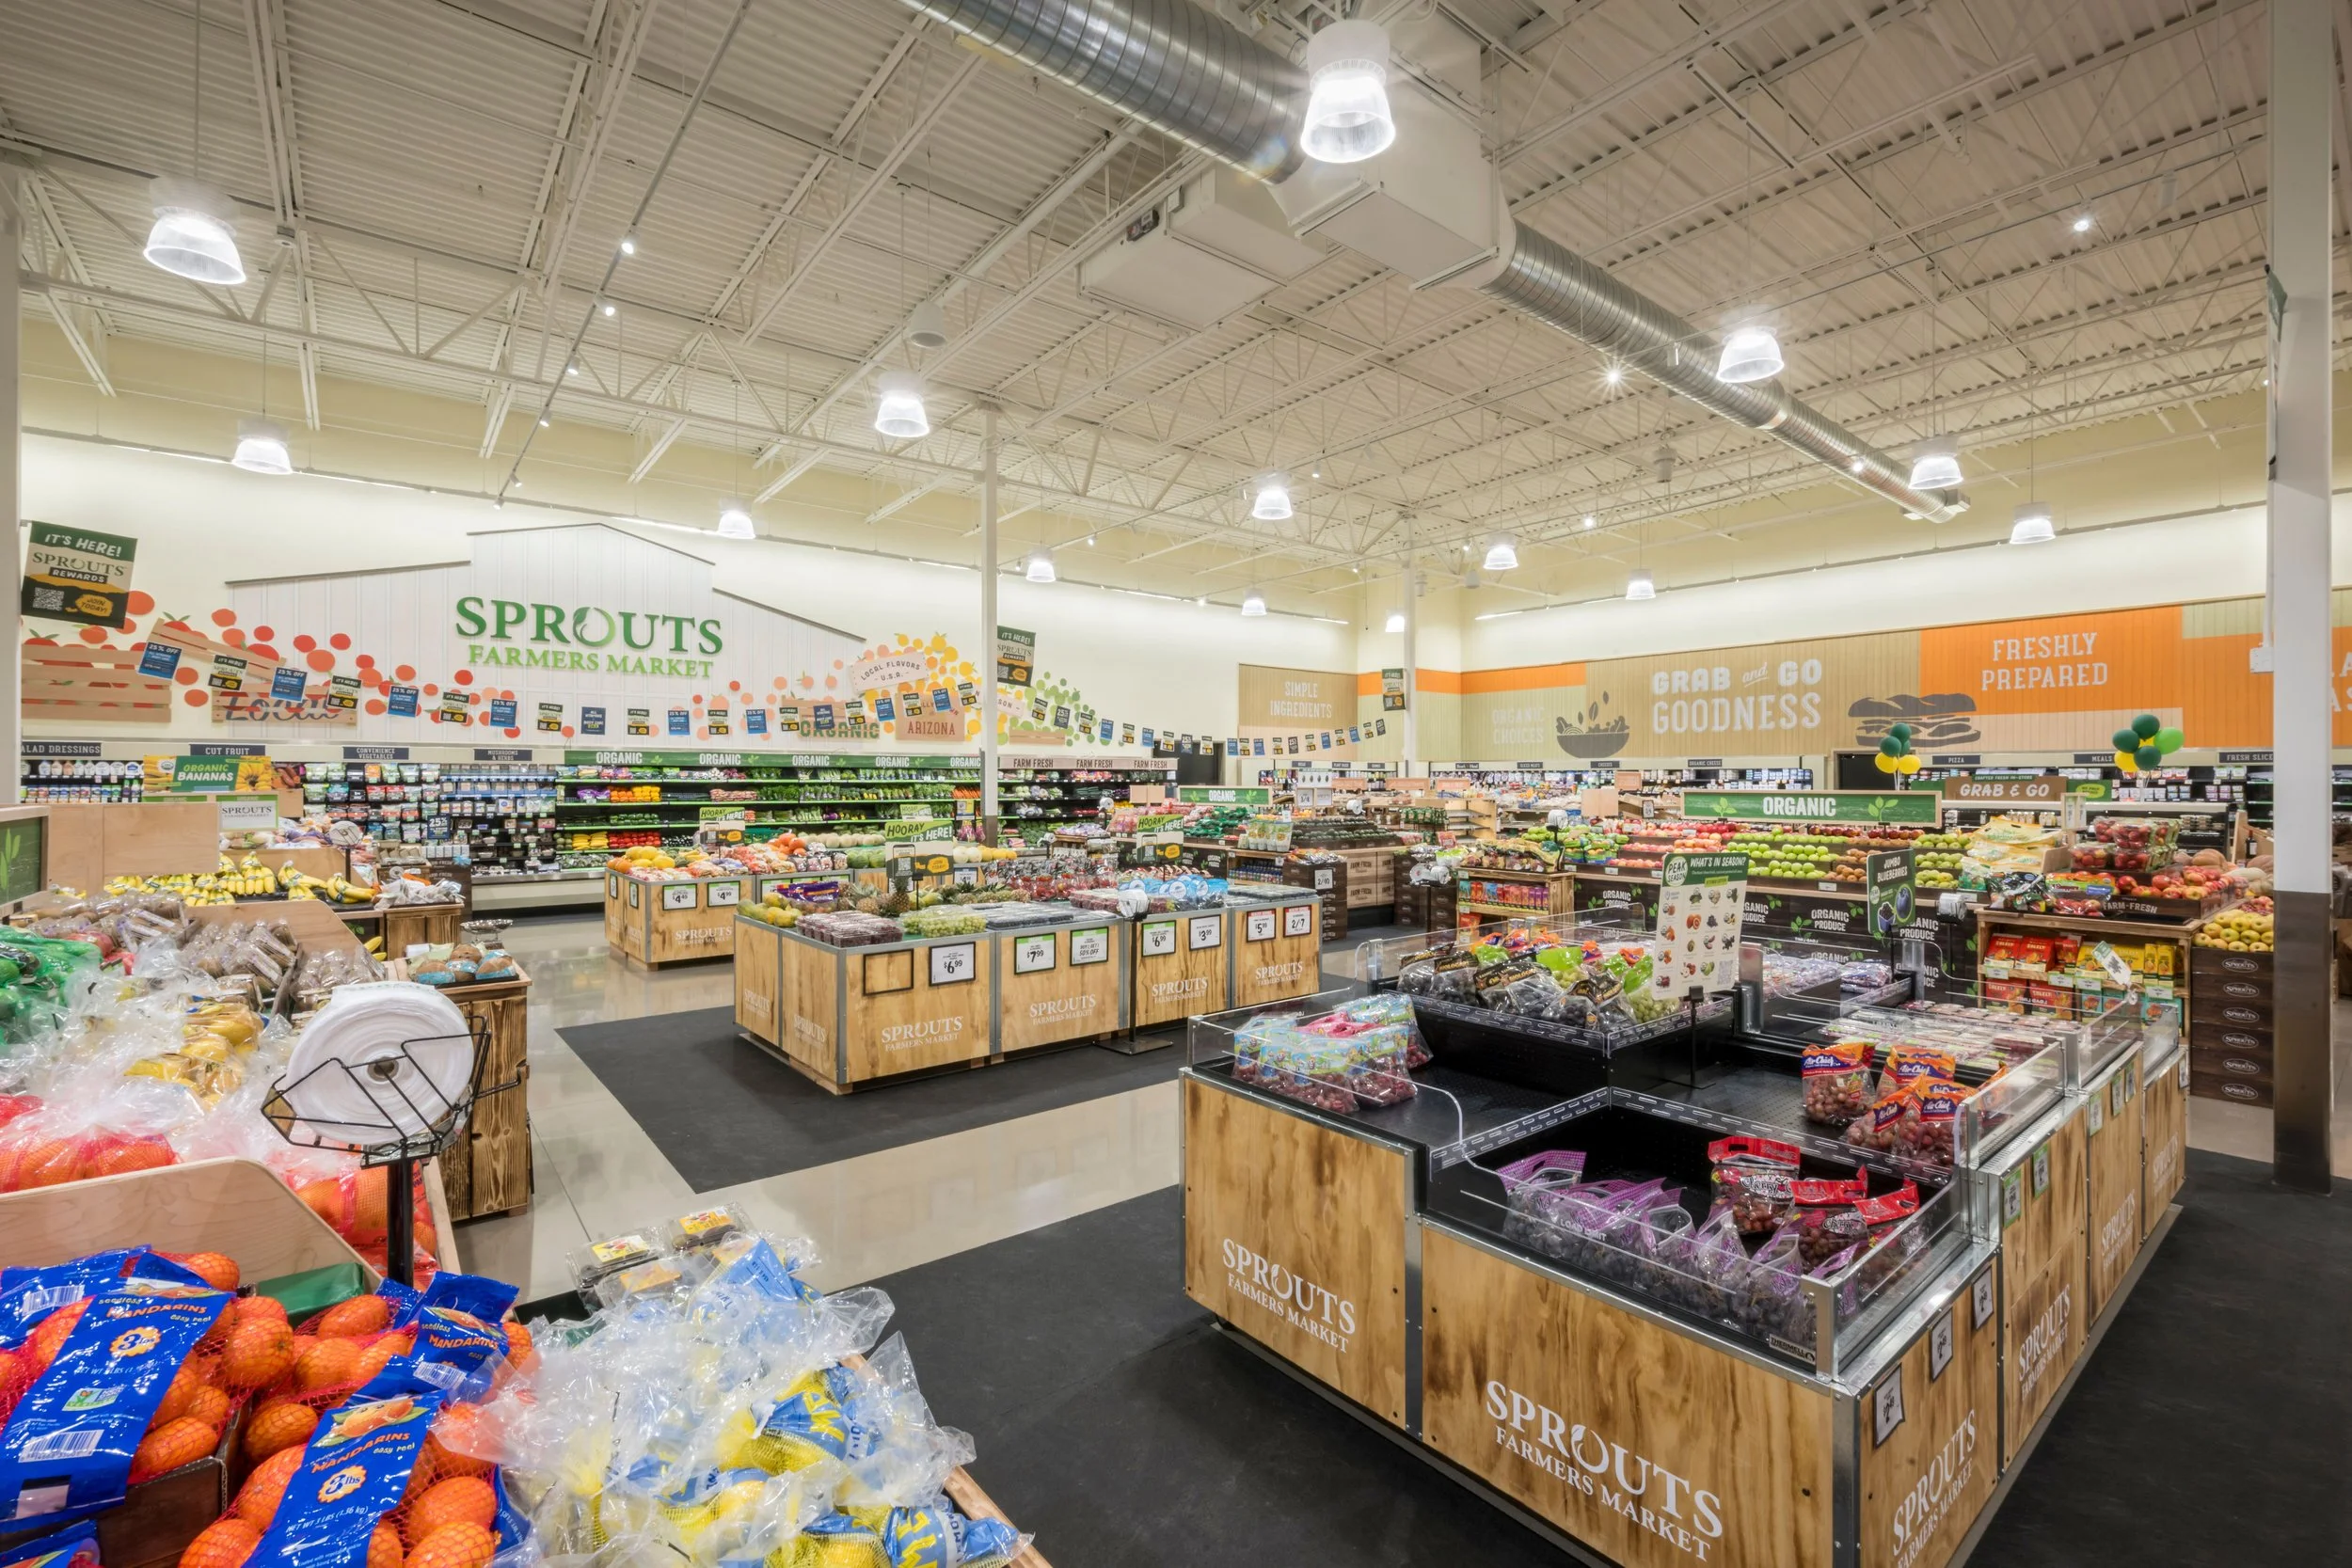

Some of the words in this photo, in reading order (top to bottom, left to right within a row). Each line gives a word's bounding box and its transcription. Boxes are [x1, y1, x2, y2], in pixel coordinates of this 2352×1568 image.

[45, 533, 72, 546] IT'S
[75, 537, 122, 557] HERE!
[32, 552, 126, 577] SPROUTS
[52, 568, 106, 583] REWARDS
[455, 596, 723, 655] SPROUTS
[1013, 633, 1031, 645] HERE!
[1993, 631, 2098, 662] FRESHLY
[997, 644, 1032, 657] SPROUTS
[469, 644, 599, 672] FARMERS
[606, 654, 714, 679] MARKET
[861, 664, 884, 681] LOCAL
[886, 660, 921, 671] FLAVORS
[1653, 667, 1730, 695] GRAB
[1741, 661, 1769, 684] and
[1777, 658, 1822, 686] GO
[1981, 661, 2108, 691] PREPARED
[1284, 681, 1318, 698] SIMPLE
[1269, 701, 1332, 719] INGREDIENTS
[1491, 707, 1545, 724] ORGANIC
[1652, 692, 1821, 735] GOODNESS
[907, 721, 956, 736] ARIZONA
[1493, 724, 1543, 744] CHOICES
[21, 744, 45, 753] ALAD
[48, 745, 101, 754] DRESSINGS
[596, 752, 643, 765] ORGANIC
[699, 753, 741, 765] ORGANIC
[792, 755, 830, 767] ORGANIC
[875, 756, 910, 768] ORGANIC
[950, 756, 981, 768] ORGANIC
[1013, 758, 1031, 768] FARM
[1032, 759, 1054, 768] FRESH
[1076, 759, 1092, 768] FARM
[1093, 760, 1113, 768] FRESH
[1134, 760, 1149, 768] FARM
[1150, 761, 1168, 769] FRESH
[183, 764, 229, 772] ORGANIC
[177, 771, 234, 782] BANANAS
[1208, 789, 1236, 802] ORGANIC
[1960, 784, 2006, 797] GRAB
[2010, 783, 2020, 798] &
[2026, 784, 2050, 797] GO
[221, 805, 272, 815] SPROUTS
[701, 808, 726, 817] HOORAY
[1763, 796, 1836, 817] ORGANIC
[726, 811, 744, 820] HERE!
[1138, 816, 1165, 828] HOORAY
[886, 823, 926, 837] HOORAY
[1165, 820, 1184, 832] HERE!
[911, 834, 924, 843] IT'S
[926, 826, 953, 840] HERE!
[1668, 862, 1687, 874] PEAK
[1690, 857, 1713, 867] WHAT'S
[1713, 858, 1721, 866] IN
[1722, 856, 1746, 866] SEASON?
[1883, 856, 1900, 869] JUMBO
[1668, 874, 1686, 882] SEASON
[1877, 866, 1908, 882] BLUEBERRIES
[1603, 891, 1631, 901] ORGANIC
[1743, 902, 1769, 914] GANIC
[2103, 901, 2158, 914] FARM-FRESH
[1811, 910, 1850, 922] ORGANIC
[1815, 921, 1846, 931] PRODUCE
[675, 927, 733, 942] SPROUTS
[1900, 929, 1934, 941] PRODUCE
[1255, 961, 1304, 980] SPROUTS
[2225, 960, 2255, 970] SPROUTS
[1152, 977, 1209, 997] SPROUTS
[2226, 985, 2257, 994] SPROUTS
[743, 989, 770, 1012] SPROUTS
[1029, 994, 1097, 1018] SPROUTS
[1032, 1013, 1065, 1025] FARMERS
[1065, 1009, 1093, 1020] MARKET
[2226, 1010, 2256, 1020] SPROUTS
[793, 1015, 826, 1043] SPROUTS
[882, 1016, 963, 1043] SPROUTS
[884, 1038, 924, 1052] FARMERS
[925, 1033, 959, 1048] MARKET
[2225, 1036, 2256, 1045] SPROUTS
[2226, 1061, 2257, 1070] SPROUTS
[1741, 1176, 1780, 1196] Cherry
[2102, 1188, 2136, 1253] SPROUTS
[1559, 1218, 1582, 1231] LOAD
[1582, 1227, 1607, 1242] LIMIT
[1222, 1237, 1356, 1337] SPROUTS
[106, 1304, 208, 1319] MANDARINS
[170, 1314, 189, 1323] easy
[1227, 1271, 1285, 1323] FARMERS
[1287, 1300, 1349, 1354] MARKET
[421, 1323, 452, 1333] seedless
[2018, 1284, 2071, 1382] SPROUTS
[118, 1333, 142, 1351] 3
[429, 1334, 499, 1351] MANDARINS
[468, 1352, 484, 1361] easy
[2021, 1357, 2045, 1402] FARMERS
[2045, 1322, 2069, 1365] MARKET
[311, 1433, 410, 1474] MANDARINS
[373, 1446, 393, 1454] easy
[396, 1442, 416, 1452] peel
[1486, 1379, 1724, 1539] SPROUTS
[325, 1474, 347, 1495] 3
[345, 1475, 360, 1485] lbs
[1892, 1409, 1976, 1559] SPROUTS
[1494, 1425, 1595, 1497] FARMERS
[1599, 1482, 1712, 1562] MARKET
[286, 1523, 301, 1532] NET
[322, 1513, 335, 1523] LBS
[355, 1505, 369, 1514] kg)
[1897, 1508, 1942, 1568] FARMERS
[1941, 1457, 1973, 1515] MARKET
